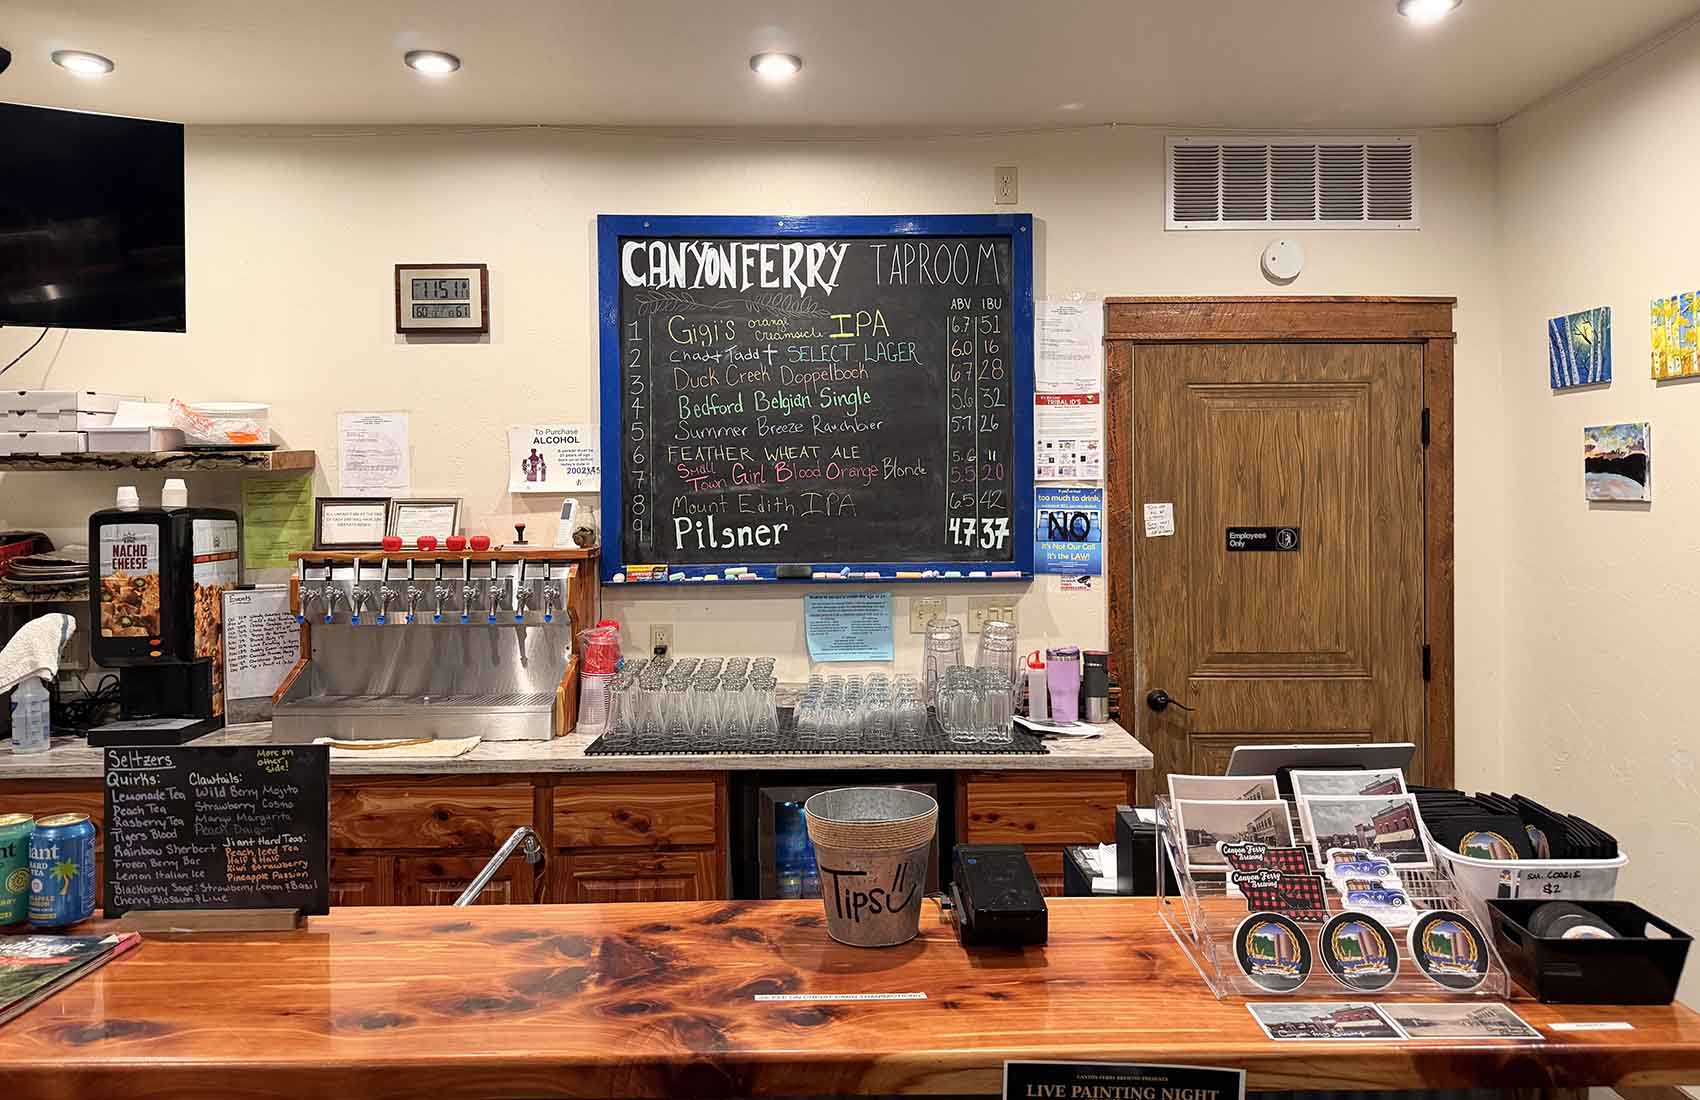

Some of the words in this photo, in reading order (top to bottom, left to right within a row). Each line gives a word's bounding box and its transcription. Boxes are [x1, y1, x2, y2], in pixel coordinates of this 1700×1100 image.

[869, 243, 1001, 286] TAPROOM
[950, 298, 972, 310] ABV
[982, 298, 1003, 310] IBU
[627, 320, 643, 342] 1
[667, 314, 736, 347] Gigi's
[746, 318, 791, 333] orange
[829, 309, 891, 338] IPA
[979, 314, 1001, 335] 51
[628, 348, 642, 369] 2
[786, 342, 857, 363] SELECT
[864, 341, 924, 366] LAGER
[951, 339, 973, 357] 6.0
[983, 339, 1000, 354] 16
[629, 375, 645, 395] 3
[672, 366, 720, 391] Duck
[725, 363, 771, 387] Creek
[780, 361, 869, 394] Doppelbock
[978, 358, 1004, 381] 28
[631, 397, 645, 420] 4
[678, 391, 744, 420] Bedford
[753, 389, 812, 416] Belgian
[819, 385, 872, 417] Single
[951, 387, 974, 410] 5.6
[979, 386, 1006, 409] 32
[535, 428, 544, 436] To
[545, 428, 579, 436] Purchase
[631, 421, 645, 442] 5
[674, 420, 750, 441] Summer
[756, 415, 804, 438] Breeze
[811, 414, 884, 436] Rauchbier
[980, 413, 999, 433] 26
[533, 436, 581, 444] ALCOHOL
[632, 445, 645, 464] 6
[667, 445, 755, 463] FEATHER
[764, 445, 821, 462] WHEAT
[830, 446, 860, 460] ALE
[952, 448, 976, 462] 5.6
[988, 449, 997, 461] 11
[631, 470, 645, 489] 7
[731, 462, 767, 486] Girl
[774, 461, 821, 483] Blood
[825, 461, 879, 487] Orange
[881, 457, 928, 481] Blonde
[951, 465, 976, 484] 5.5
[981, 463, 1005, 481] 20
[676, 462, 717, 479] Small
[685, 475, 728, 493] Town
[632, 494, 646, 515] 8
[671, 495, 729, 515] Mount
[738, 494, 795, 517] Edith
[800, 491, 858, 518] IPA
[979, 490, 1007, 510] 42
[1039, 494, 1050, 502] too
[1051, 494, 1070, 502] much
[1072, 494, 1080, 502] to
[632, 518, 643, 543] 9
[672, 514, 789, 550] Pilsner
[949, 517, 976, 547] 4.7
[980, 517, 1010, 550] 37
[1048, 511, 1091, 540] NO
[1229, 531, 1267, 542] Employees
[112, 544, 148, 558] NACHO
[1052, 543, 1066, 551] Not
[1229, 540, 1246, 549] Only
[1057, 552, 1070, 560] the
[111, 557, 149, 570] CHEESE
[108, 750, 173, 768] Seltzers
[256, 749, 280, 758] More
[257, 757, 285, 766] other
[265, 760, 289, 774] side!
[106, 771, 161, 787] Quirks:
[188, 772, 243, 785] Clawtails:
[111, 789, 165, 803] Lemonade
[165, 786, 186, 800] Tea
[195, 786, 226, 798] Wild
[229, 785, 259, 800] Berry
[262, 784, 299, 799] Mojito
[112, 805, 145, 817] Peach
[144, 803, 168, 814] Tea
[194, 801, 256, 814] Strawberry
[261, 799, 294, 809] Cosmo
[112, 815, 167, 830] Rasberry
[166, 815, 185, 827] Tea
[110, 830, 148, 847] Tigers
[149, 828, 178, 840] Blood
[222, 836, 256, 847] Jiant
[257, 835, 282, 846] Hard
[114, 844, 163, 858] Rainbow
[165, 842, 217, 855] Sherbert
[224, 847, 255, 858] Peach
[257, 847, 279, 857] Iced
[281, 844, 300, 853] Tea
[1222, 846, 1246, 856] Canyon
[1246, 844, 1266, 854] Ferry
[112, 858, 148, 870] Frozen
[149, 857, 179, 872] Berry
[182, 855, 202, 866] Bar
[226, 863, 247, 873] Kiwi
[251, 859, 309, 872] Strawberry
[227, 855, 249, 865] Half
[115, 871, 152, 881] Lemon
[155, 869, 189, 880] Italian
[191, 869, 206, 878] Ice
[226, 872, 269, 883] Pineapple
[272, 869, 309, 880] Passion
[1233, 872, 1260, 883] Canyon
[1259, 871, 1281, 881] Ferry
[111, 882, 169, 896] Blackberry
[256, 880, 283, 892] Lemon
[1250, 881, 1278, 889] Brewing
[1542, 883, 1562, 895] $2
[113, 894, 151, 907] Cherry
[1025, 1083, 1066, 1098] LIVE
[1071, 1084, 1157, 1100] PAINTING
[1161, 1087, 1220, 1100] NIGHT
